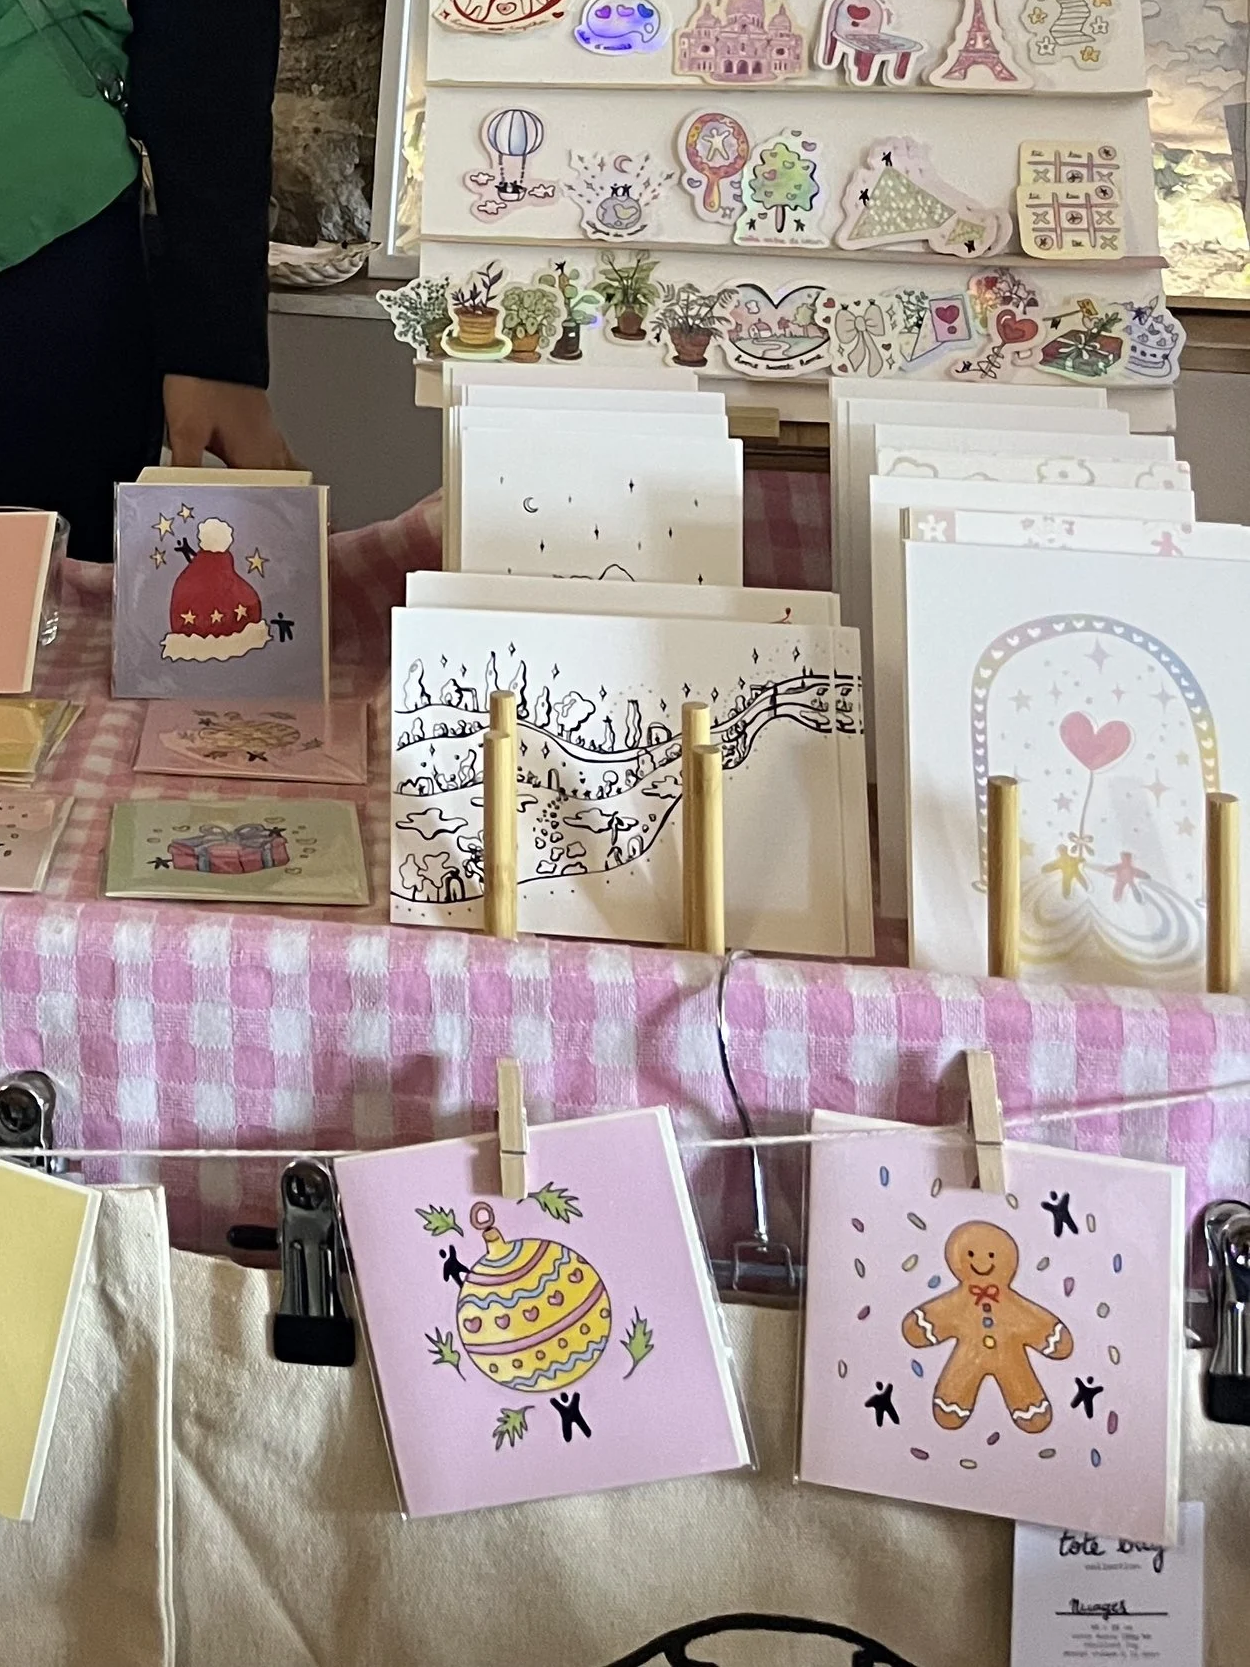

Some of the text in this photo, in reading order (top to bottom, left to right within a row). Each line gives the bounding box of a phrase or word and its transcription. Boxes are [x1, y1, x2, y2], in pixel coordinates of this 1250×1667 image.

[734, 354, 759, 369] home
[799, 354, 825, 367] home
[1058, 1530, 1107, 1557] tote
[1069, 1597, 1130, 1621] Nuages
